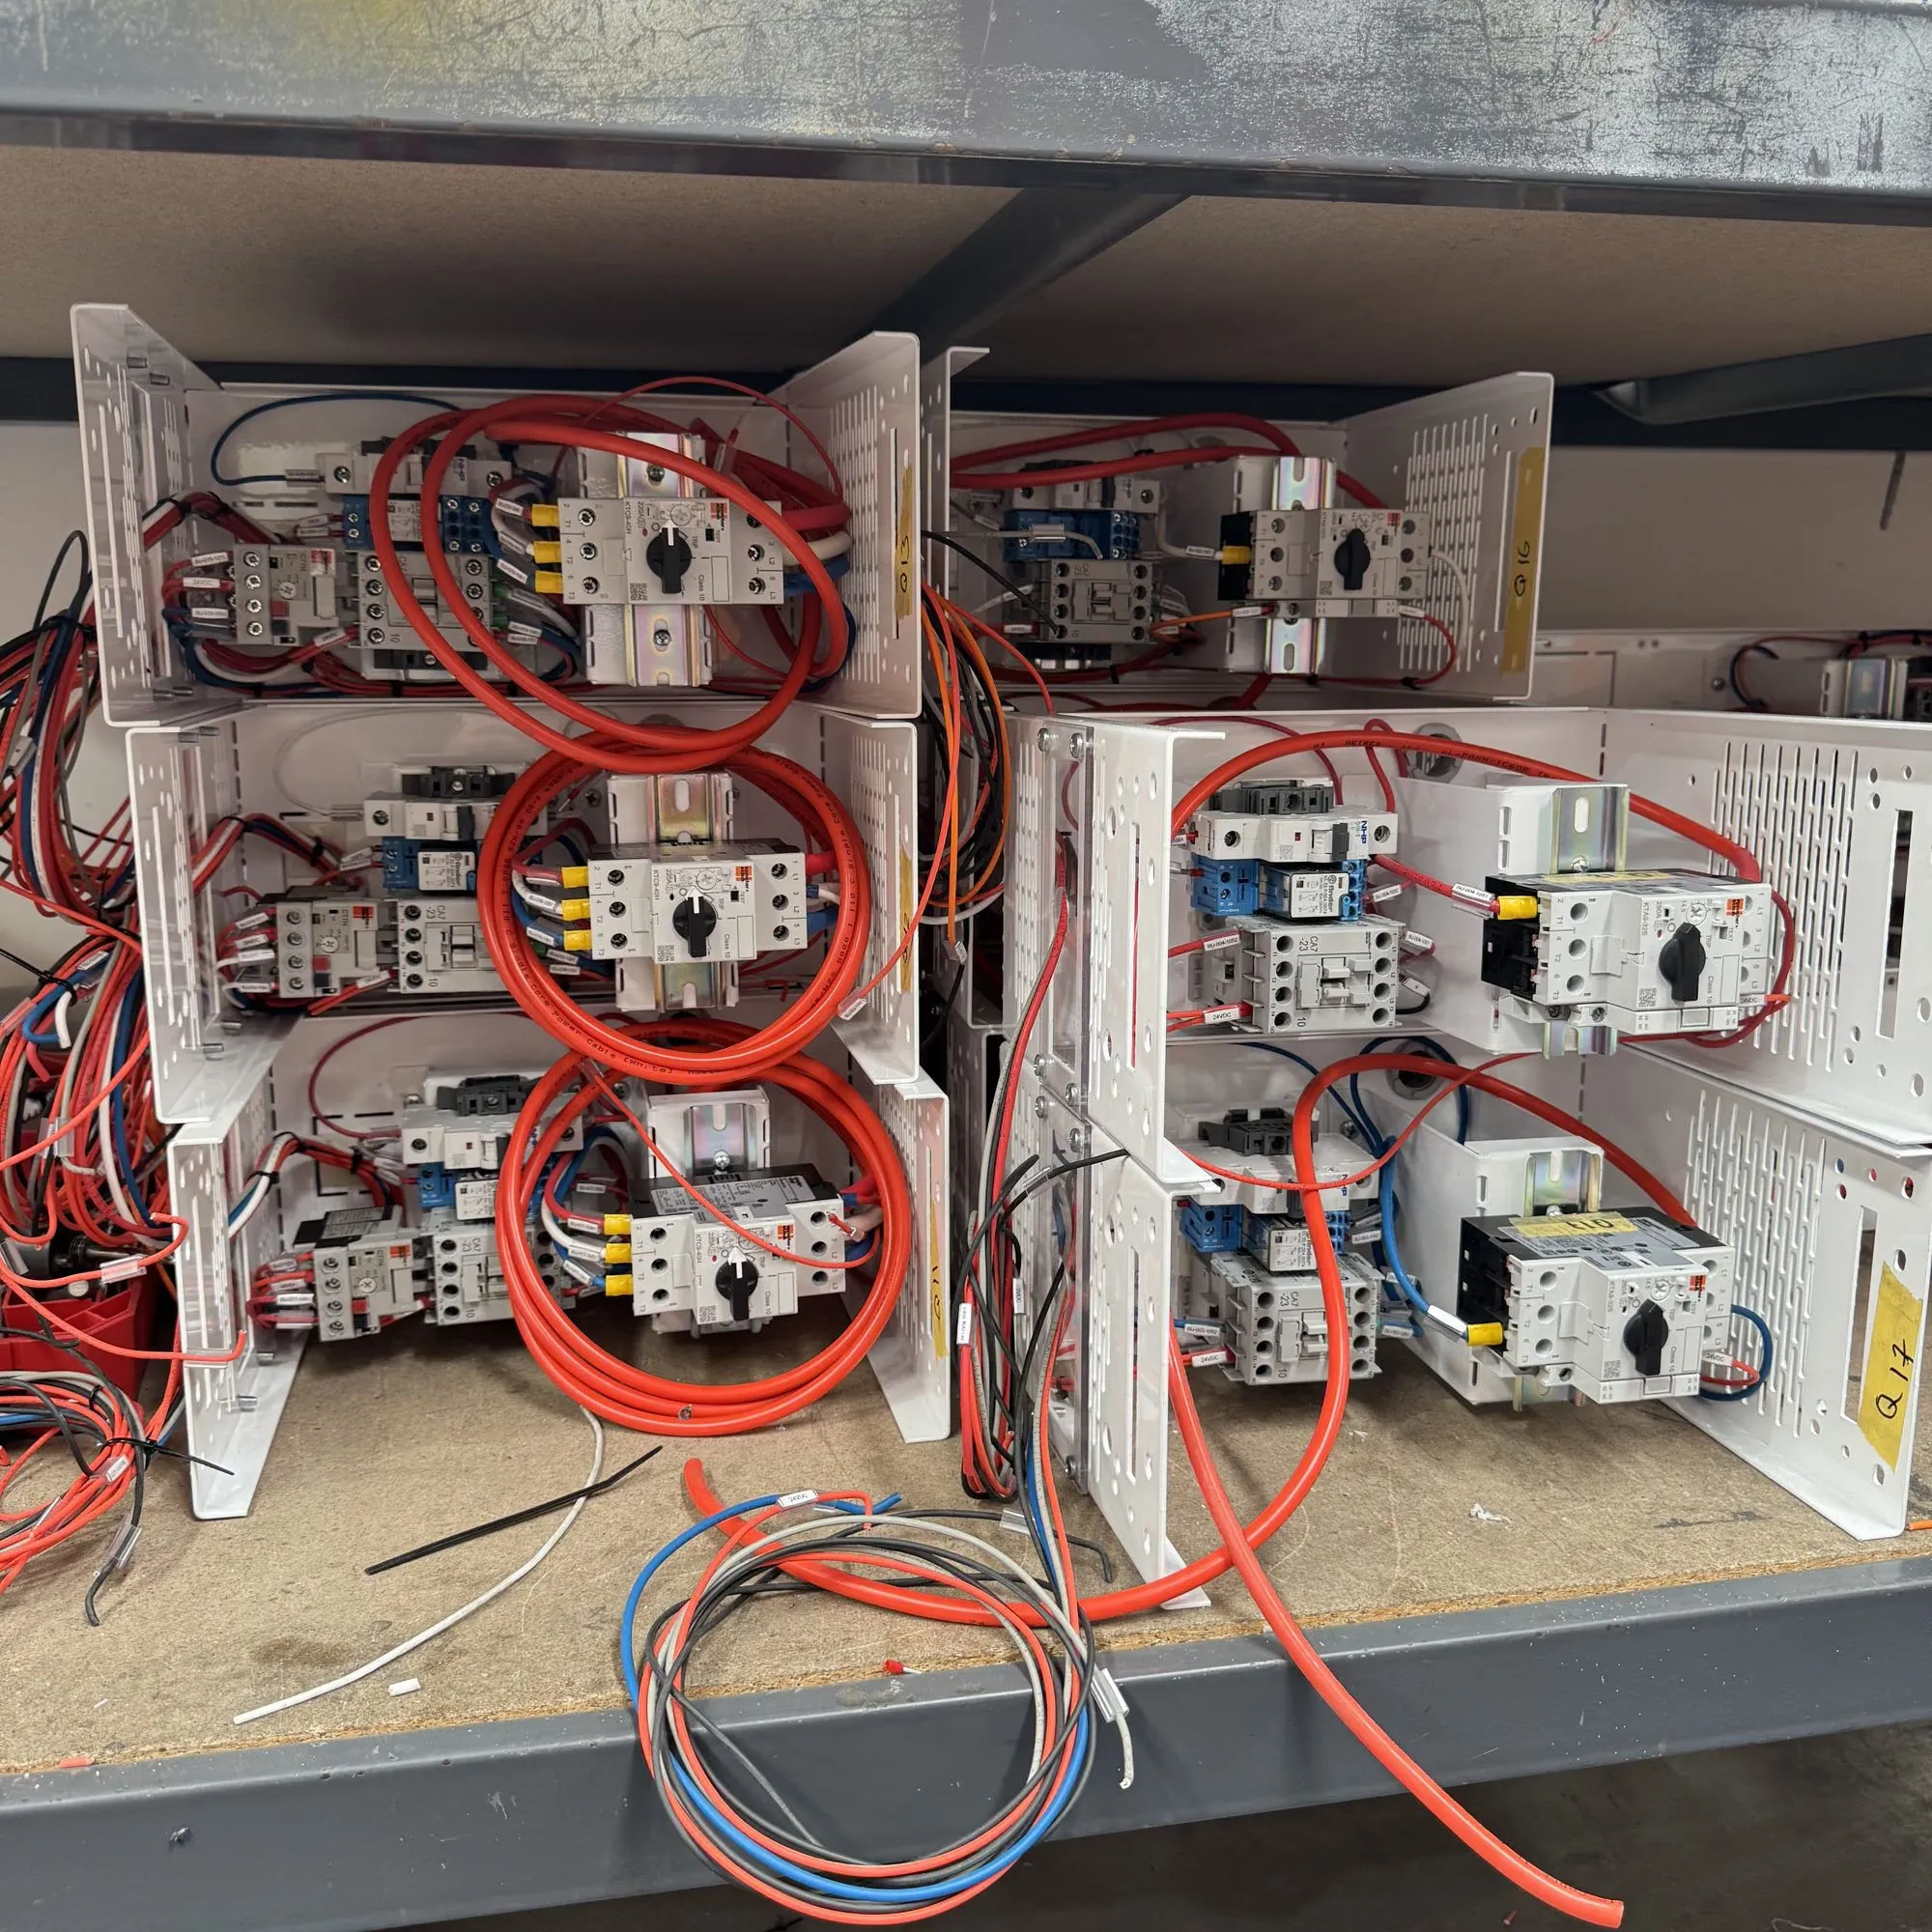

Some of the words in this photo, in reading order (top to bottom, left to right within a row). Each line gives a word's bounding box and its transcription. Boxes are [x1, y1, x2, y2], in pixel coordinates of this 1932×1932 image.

[389, 633, 400, 643] 10
[825, 801, 840, 824] Core
[595, 882, 602, 891] T1
[652, 869, 661, 900] KTC9-40H
[849, 893, 858, 913] 110
[426, 906, 435, 921] -23
[437, 905, 446, 921] CA7
[1757, 906, 1764, 915] L1
[596, 915, 604, 923] T2
[1556, 916, 1564, 924] T1
[1298, 937, 1309, 952] -23
[1309, 936, 1319, 952] CA7
[1753, 945, 1761, 953] L2
[598, 948, 605, 956] T3
[1554, 953, 1561, 963] T2
[428, 978, 439, 987] 10
[1751, 980, 1758, 989] L3
[1552, 990, 1559, 1000] T3
[1706, 995, 1713, 1004] 10
[509, 942, 529, 980] Single
[531, 983, 551, 1008] Core
[552, 1010, 582, 1036] Power
[586, 1038, 616, 1059] Cable
[1740, 996, 1758, 1005] 24VDC
[1212, 1011, 1232, 1020] 24VDC
[1296, 1016, 1307, 1028] 10
[463, 1238, 472, 1253] -23
[471, 1237, 481, 1253] CA7
[638, 1272, 644, 1281] T2
[1525, 1284, 1533, 1293] T1
[1279, 1293, 1290, 1307] -23
[1290, 1292, 1299, 1307] CA7
[1607, 1281, 1616, 1313] KTA9-32S
[639, 1303, 646, 1312] T3
[466, 1308, 475, 1318] 10
[1200, 1354, 1219, 1364] 24VDC
[1278, 1368, 1288, 1378] 10
[1668, 1364, 1675, 1373] 10
